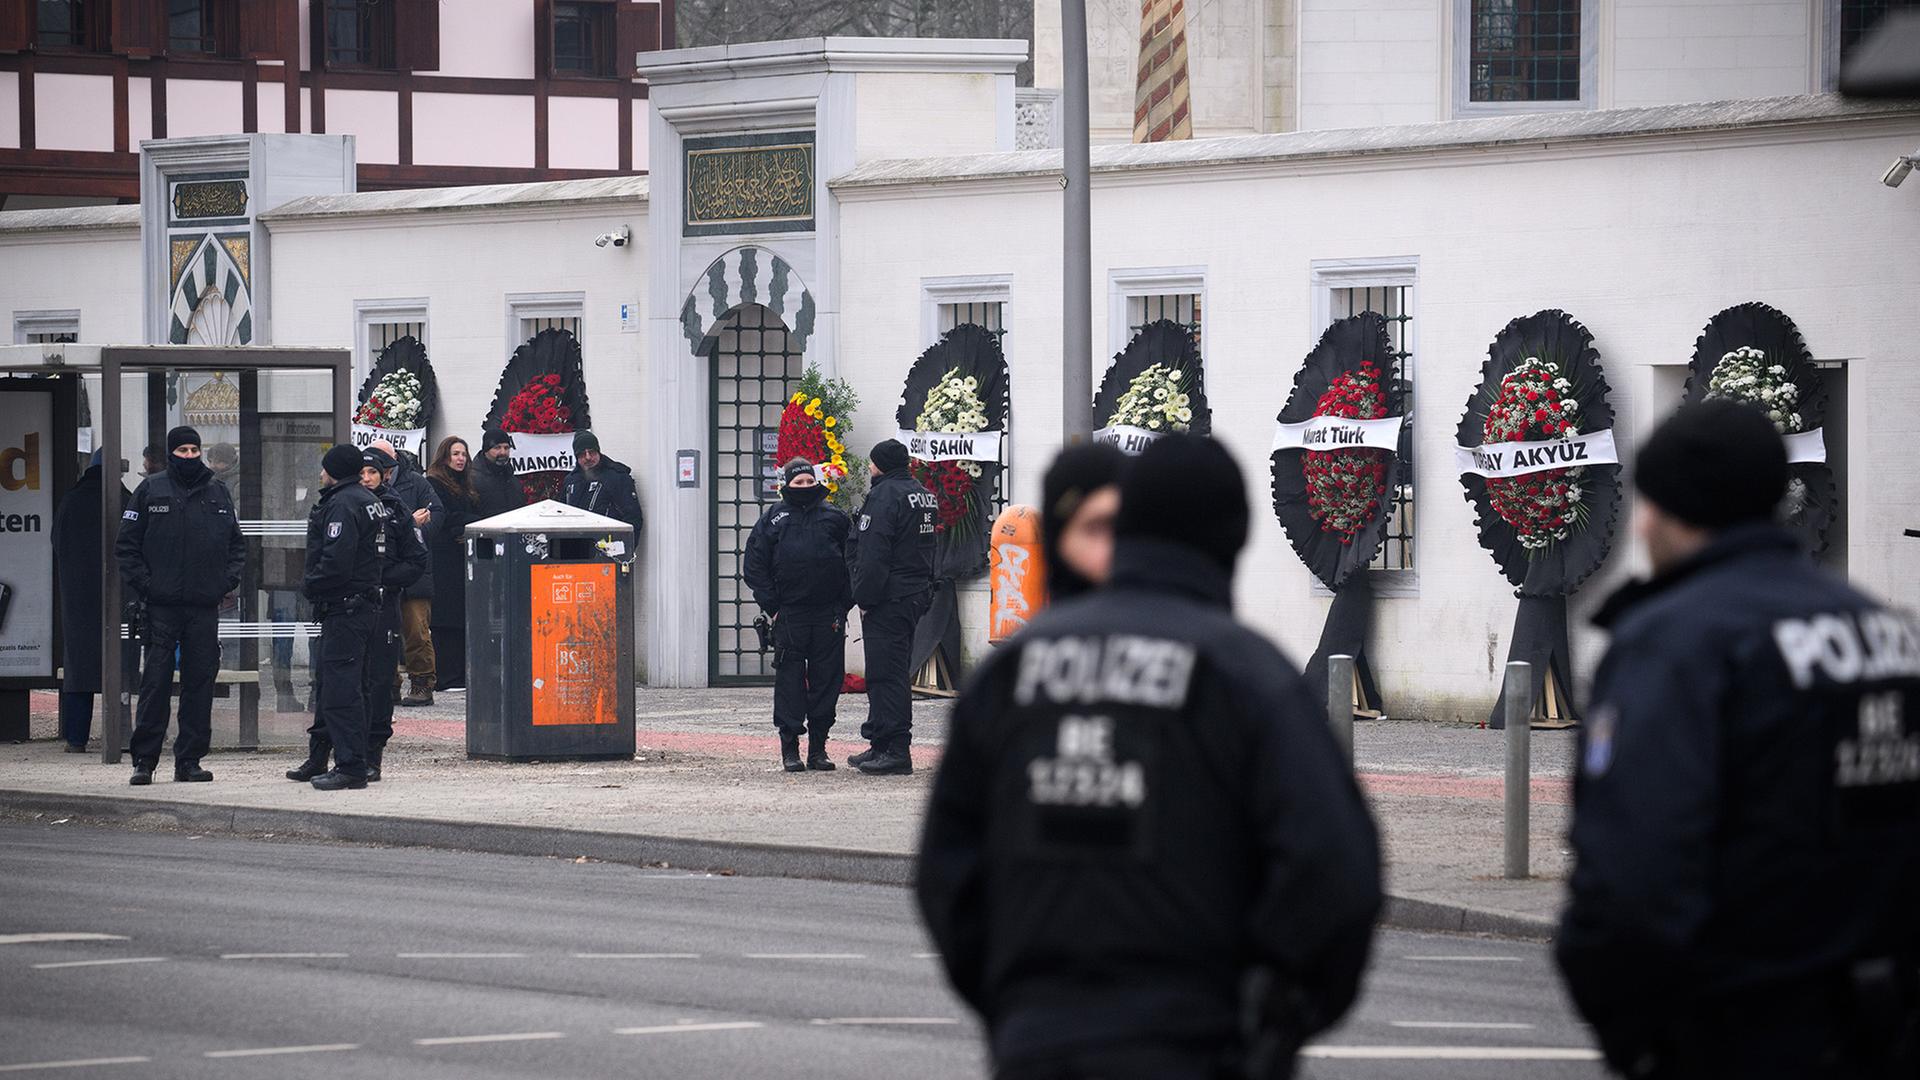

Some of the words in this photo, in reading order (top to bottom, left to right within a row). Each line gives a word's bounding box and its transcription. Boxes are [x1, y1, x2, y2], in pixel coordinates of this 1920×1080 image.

[930, 434, 974, 460] ŞAHİN
[1330, 426, 1365, 444] Türk
[510, 451, 577, 472] MANOĞL
[1513, 440, 1588, 468] AKYÜZ
[1015, 636, 1195, 708] POLIZEI
[1058, 716, 1113, 757] BE
